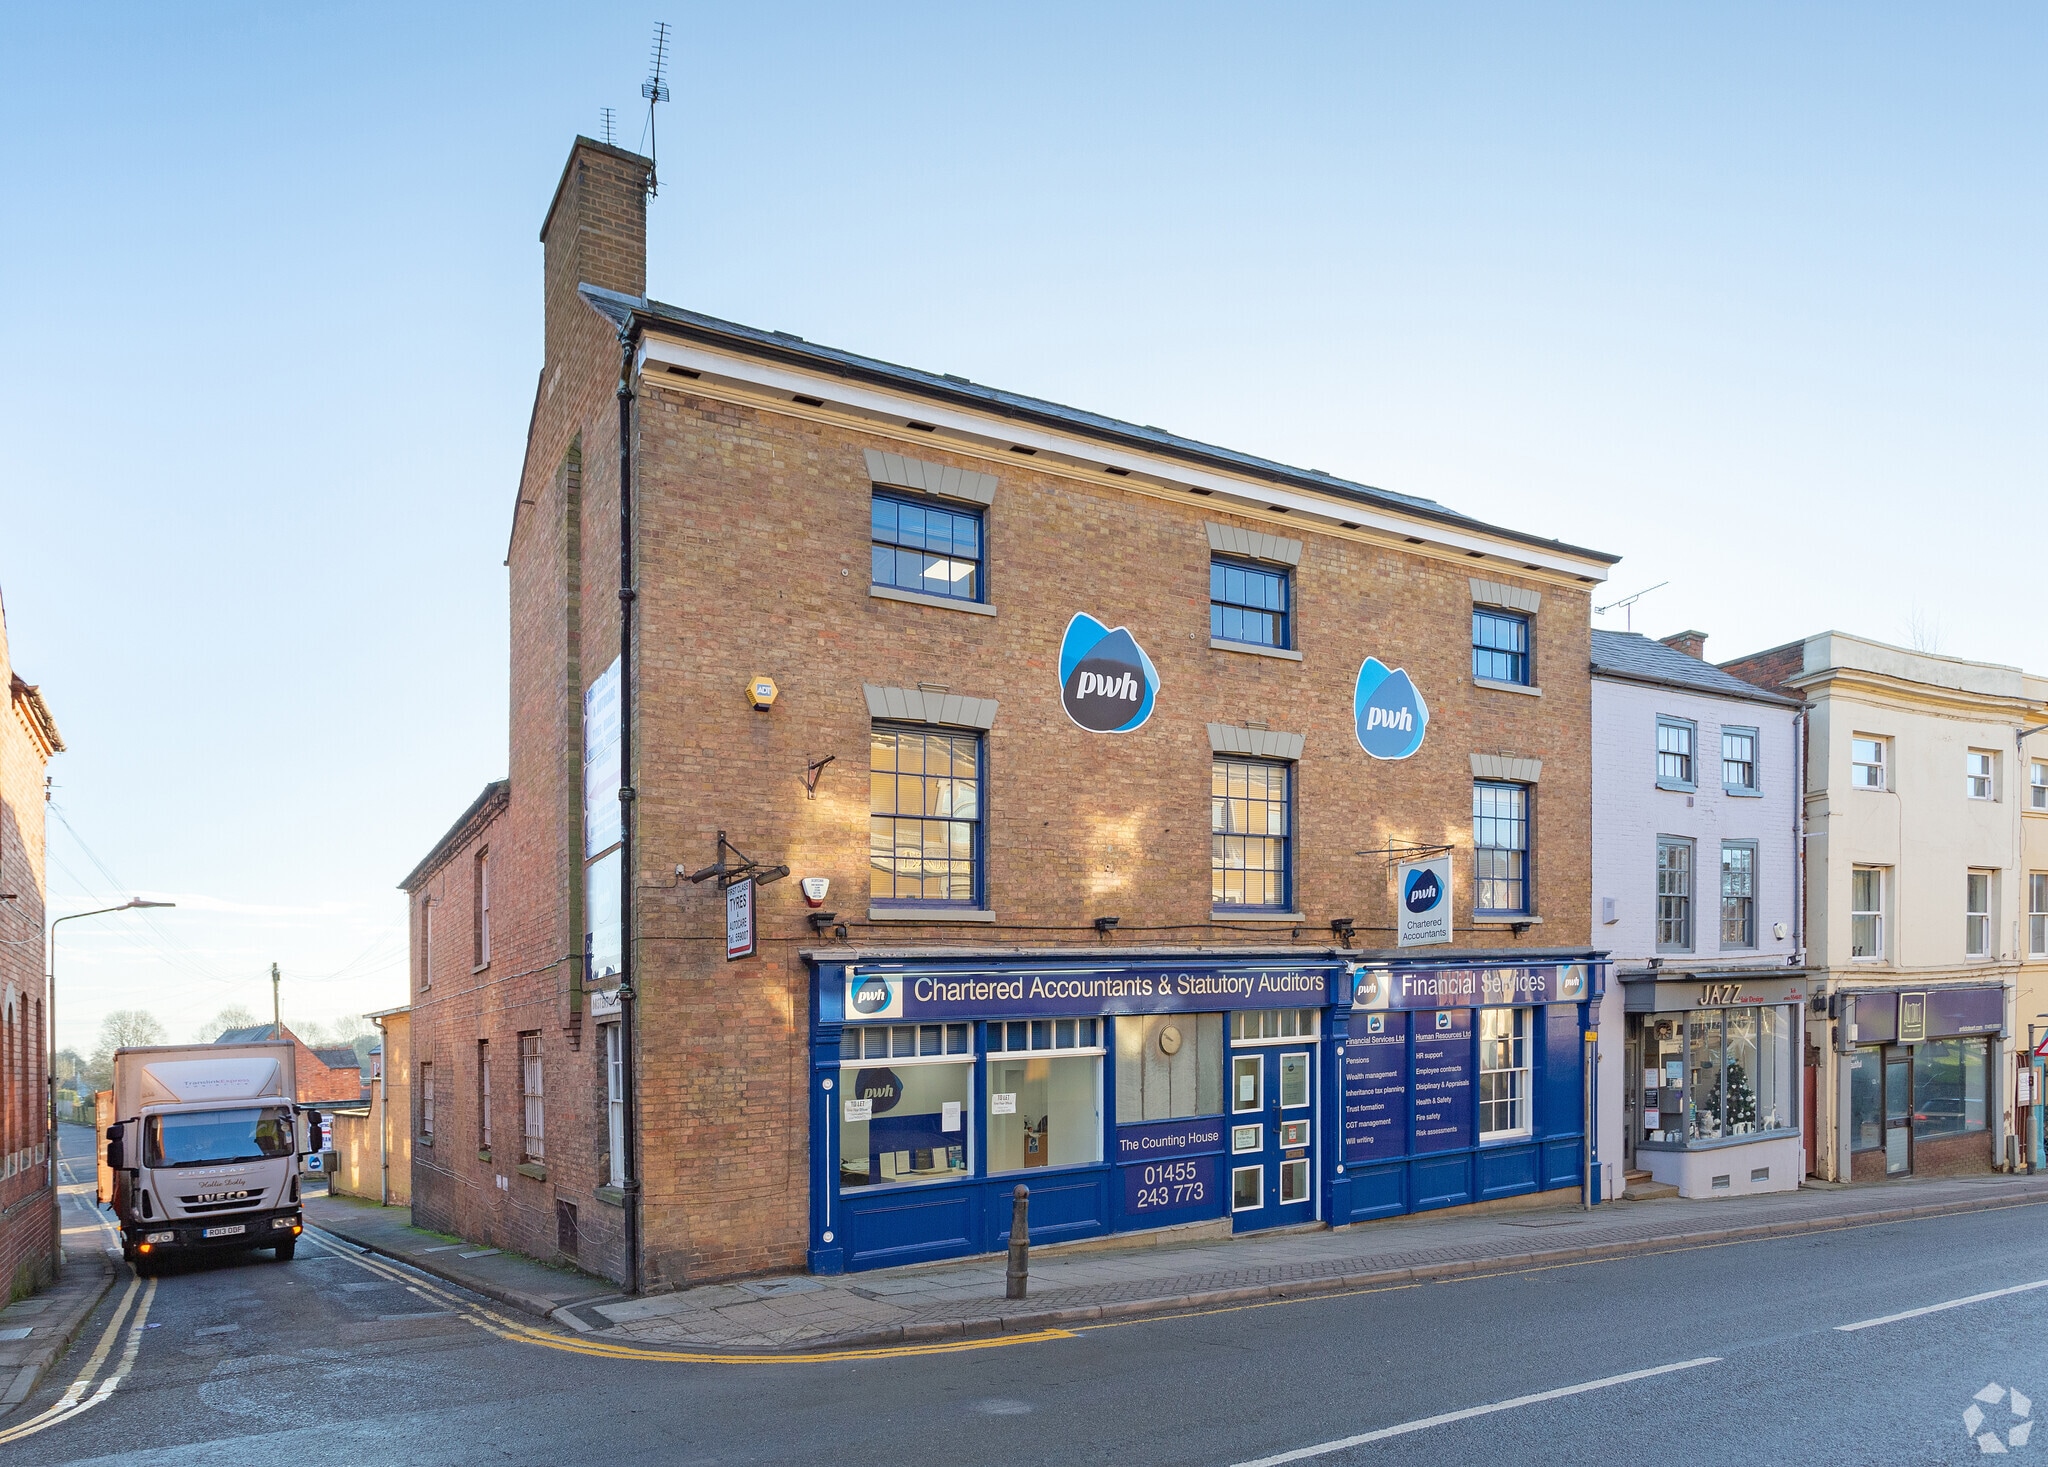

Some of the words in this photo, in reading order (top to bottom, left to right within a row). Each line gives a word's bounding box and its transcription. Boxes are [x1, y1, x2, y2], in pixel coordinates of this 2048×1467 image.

[757, 685, 771, 695] ADT
[1076, 671, 1138, 701] pwh
[1366, 706, 1413, 732] pwh
[1410, 885, 1437, 903] pwh
[730, 894, 747, 912] TYRES
[730, 917, 747, 930] AUTOCARE
[1407, 918, 1442, 930] Chartered
[1402, 929, 1447, 941] Accountants
[914, 977, 1023, 1002] Chartered
[1029, 975, 1153, 999] Accountants
[1158, 974, 1172, 995] &
[1177, 972, 1254, 998] Statutory
[1258, 972, 1325, 993] Auditors
[1357, 983, 1377, 996] pwh
[1402, 973, 1476, 997] Financial
[1481, 971, 1546, 994] Services
[1564, 978, 1581, 989] pwh
[857, 988, 886, 1004] pwh
[1700, 984, 1743, 1006] JAZZ
[1346, 1036, 1370, 1045] Financial
[1371, 1035, 1394, 1043] Services
[1395, 1034, 1405, 1042] Ltd
[1346, 1057, 1370, 1065] Pensions
[1424, 1051, 1444, 1060] support
[1346, 1072, 1364, 1080] Wealth
[1365, 1071, 1397, 1080] management
[1415, 1067, 1439, 1076] Employee
[1440, 1065, 1462, 1073] contracts
[1445, 1080, 1470, 1089] Appraisals
[864, 1084, 894, 1099] pwh
[1346, 1088, 1374, 1097] Inheritance
[1383, 1085, 1405, 1095] planning
[1415, 1098, 1431, 1106] Health
[1436, 1096, 1452, 1104] Safety
[1346, 1105, 1359, 1113] Trust
[1360, 1103, 1384, 1111] formation
[1426, 1113, 1441, 1121] safety
[1346, 1121, 1358, 1129] CGT
[1358, 1118, 1391, 1128] management
[1415, 1129, 1427, 1137] Risk
[1427, 1126, 1458, 1135] assessments
[1119, 1139, 1139, 1151] The
[1141, 1134, 1186, 1148] Counting
[1188, 1132, 1219, 1144] House
[1346, 1137, 1356, 1145] Will
[1356, 1136, 1374, 1144] writing
[1144, 1161, 1196, 1185] 01455
[197, 1190, 248, 1204] IVECO
[1137, 1186, 1169, 1208] 243
[1173, 1182, 1204, 1203] 773
